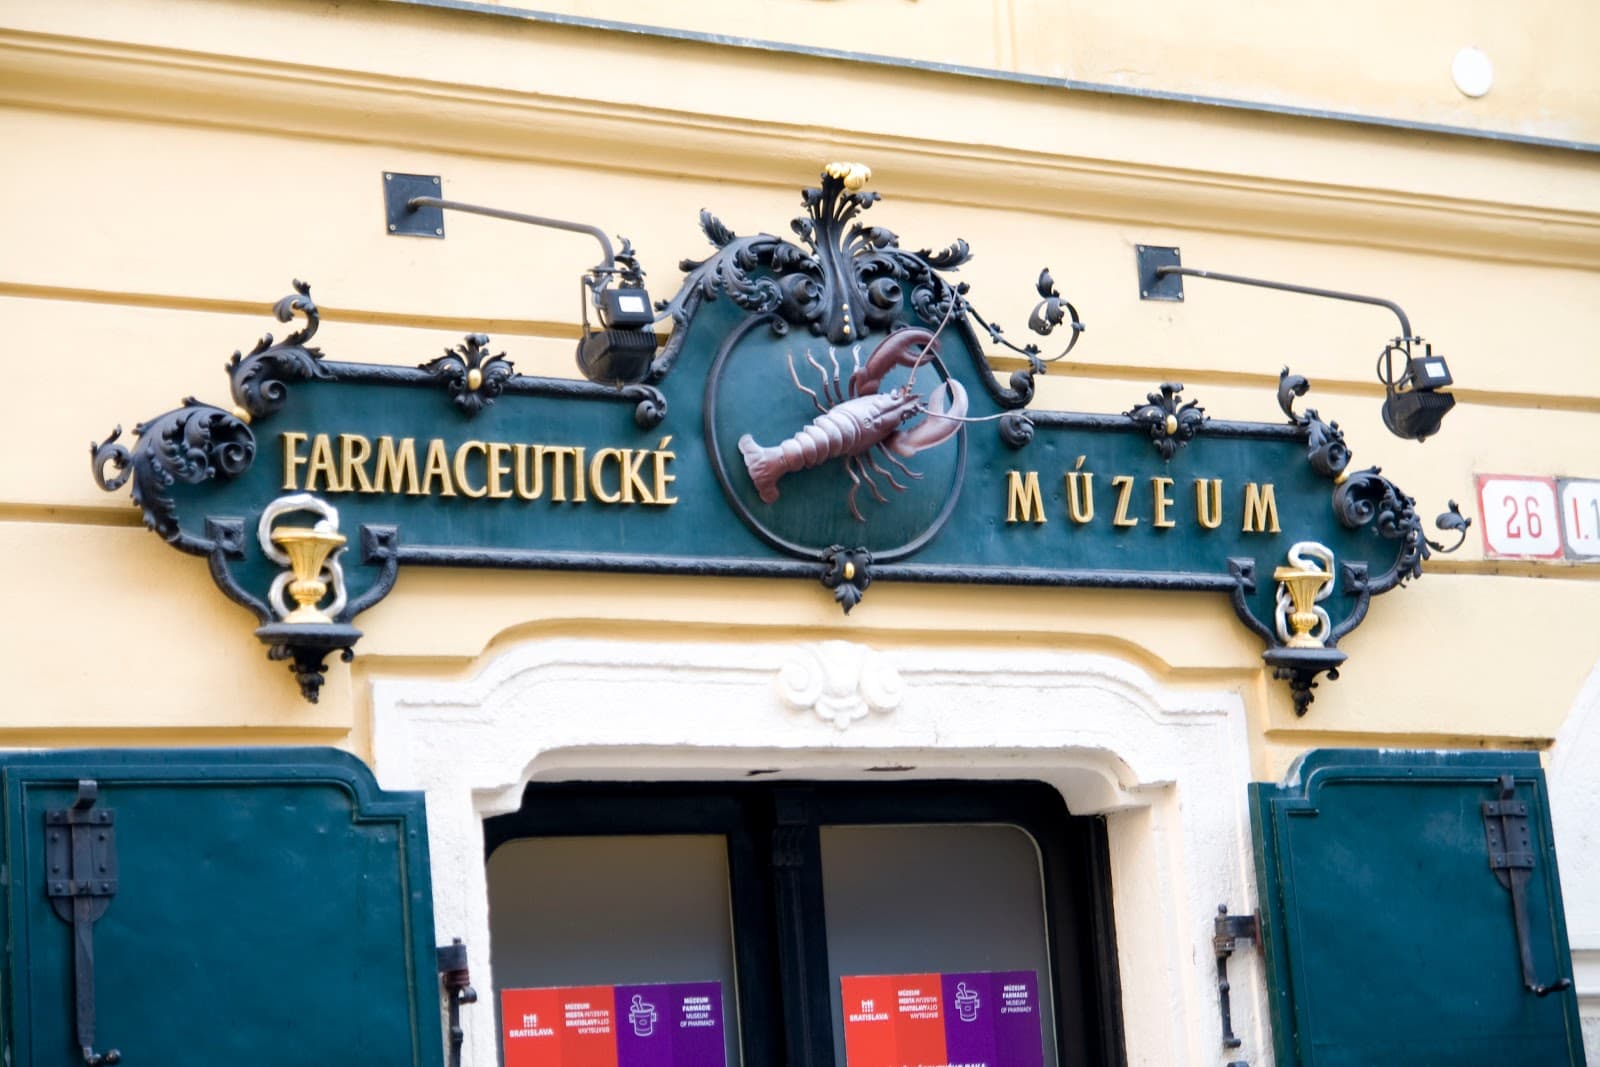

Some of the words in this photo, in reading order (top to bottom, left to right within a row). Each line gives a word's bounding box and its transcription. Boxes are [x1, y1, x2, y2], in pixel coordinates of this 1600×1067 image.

[281, 432, 678, 505] FARMACEUTICKÉ
[1005, 455, 1281, 532] MÚZEUM
[1502, 495, 1543, 539] 26
[849, 1013, 889, 1022] BRATISLAVA
[509, 1028, 554, 1038] BRATISLAVA
